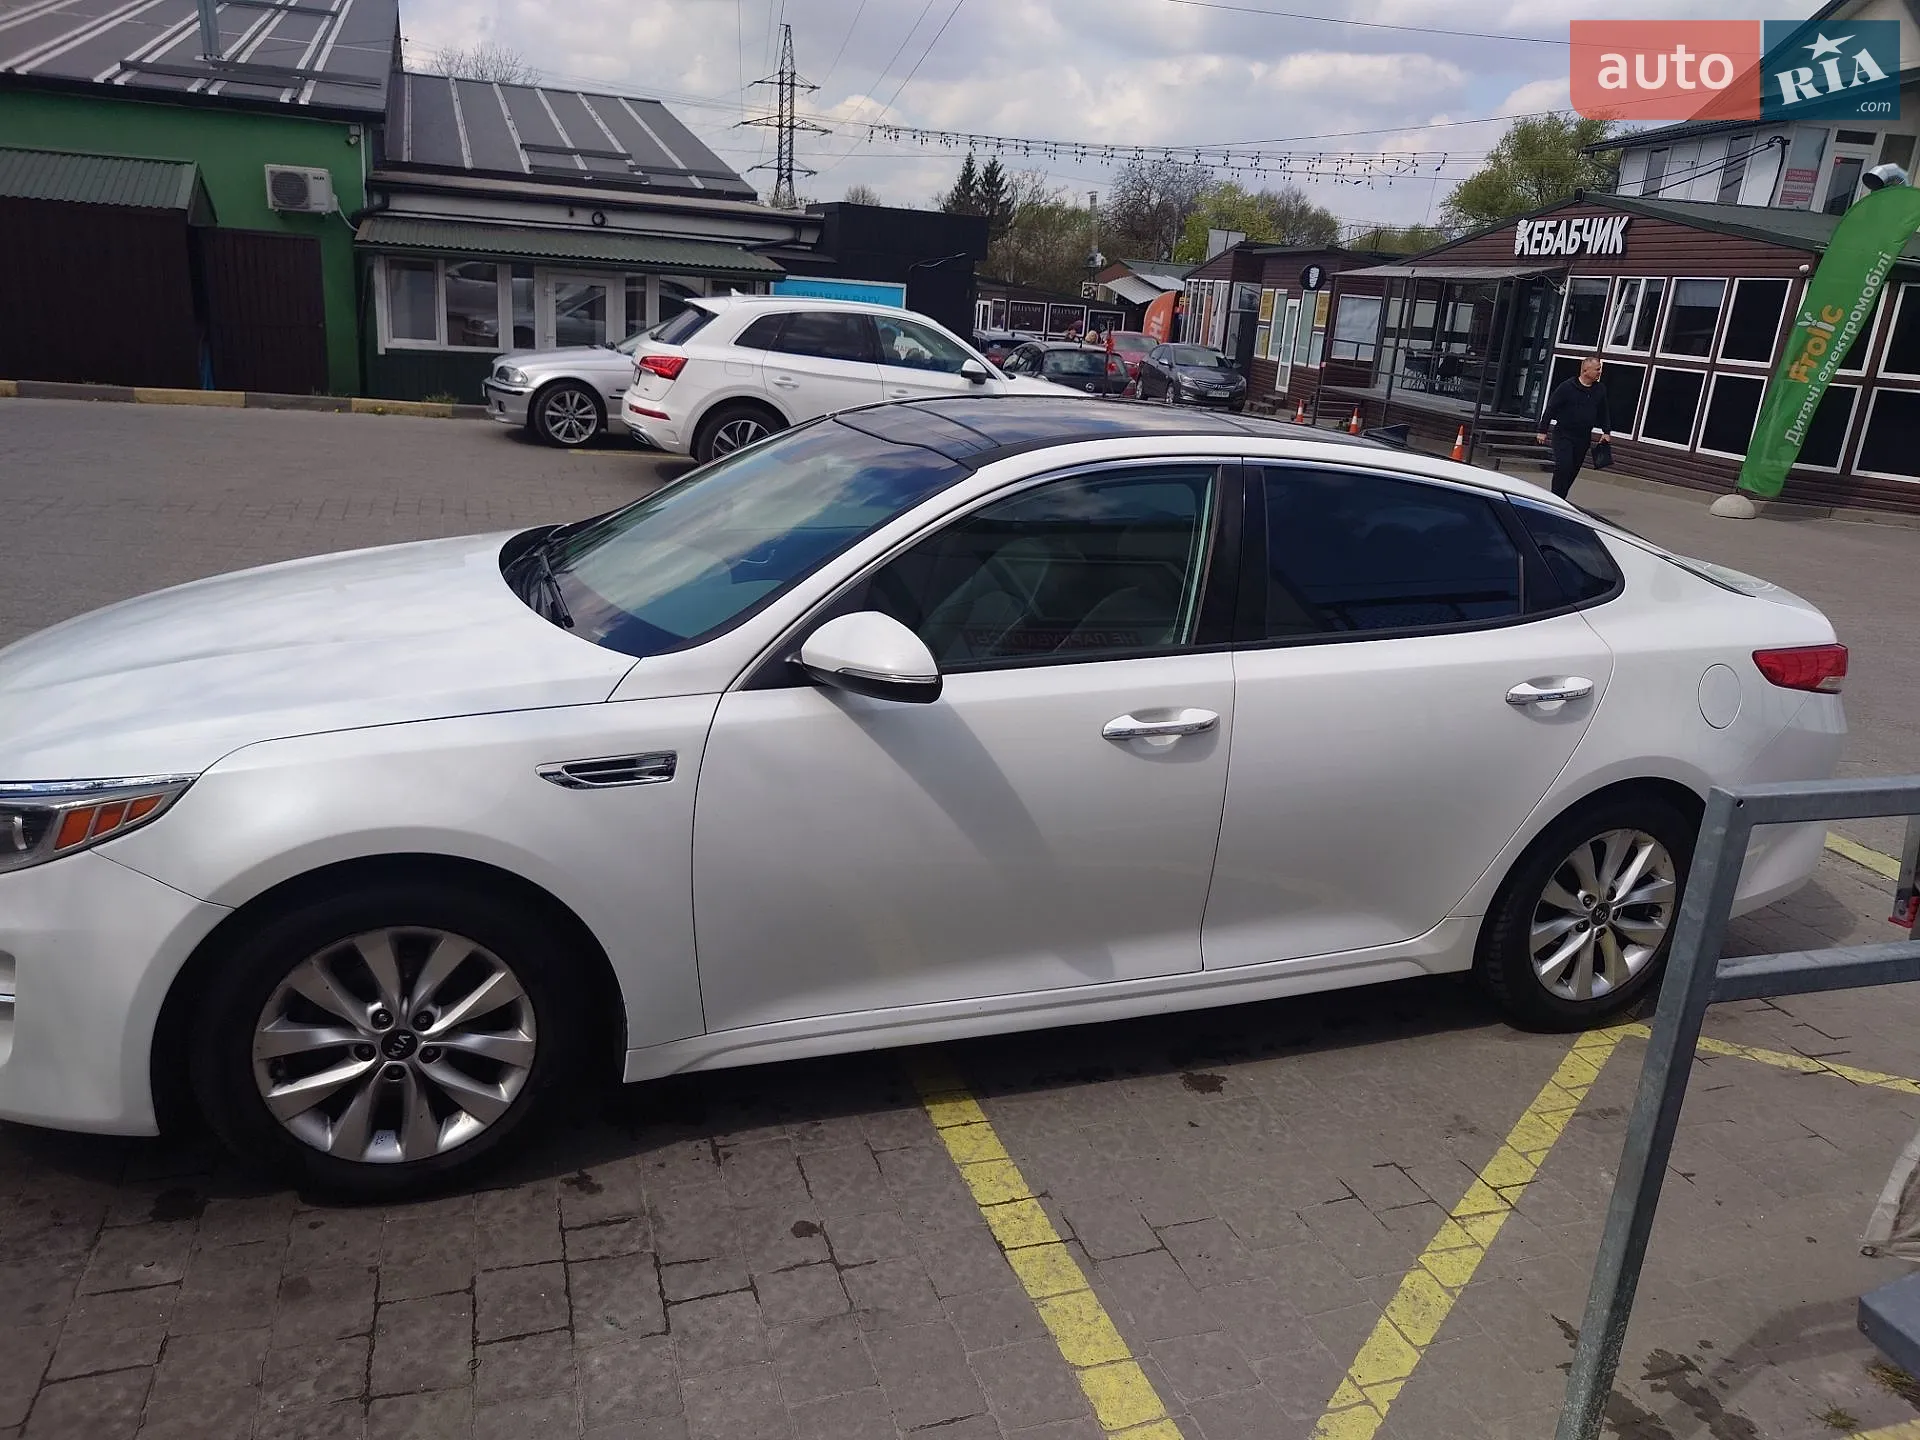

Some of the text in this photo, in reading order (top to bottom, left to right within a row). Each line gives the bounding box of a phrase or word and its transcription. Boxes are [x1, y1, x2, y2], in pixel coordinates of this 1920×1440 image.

[1514, 216, 1629, 256] КЕБАБЧИК
[1784, 251, 1892, 446] Дитячі електромобілі
